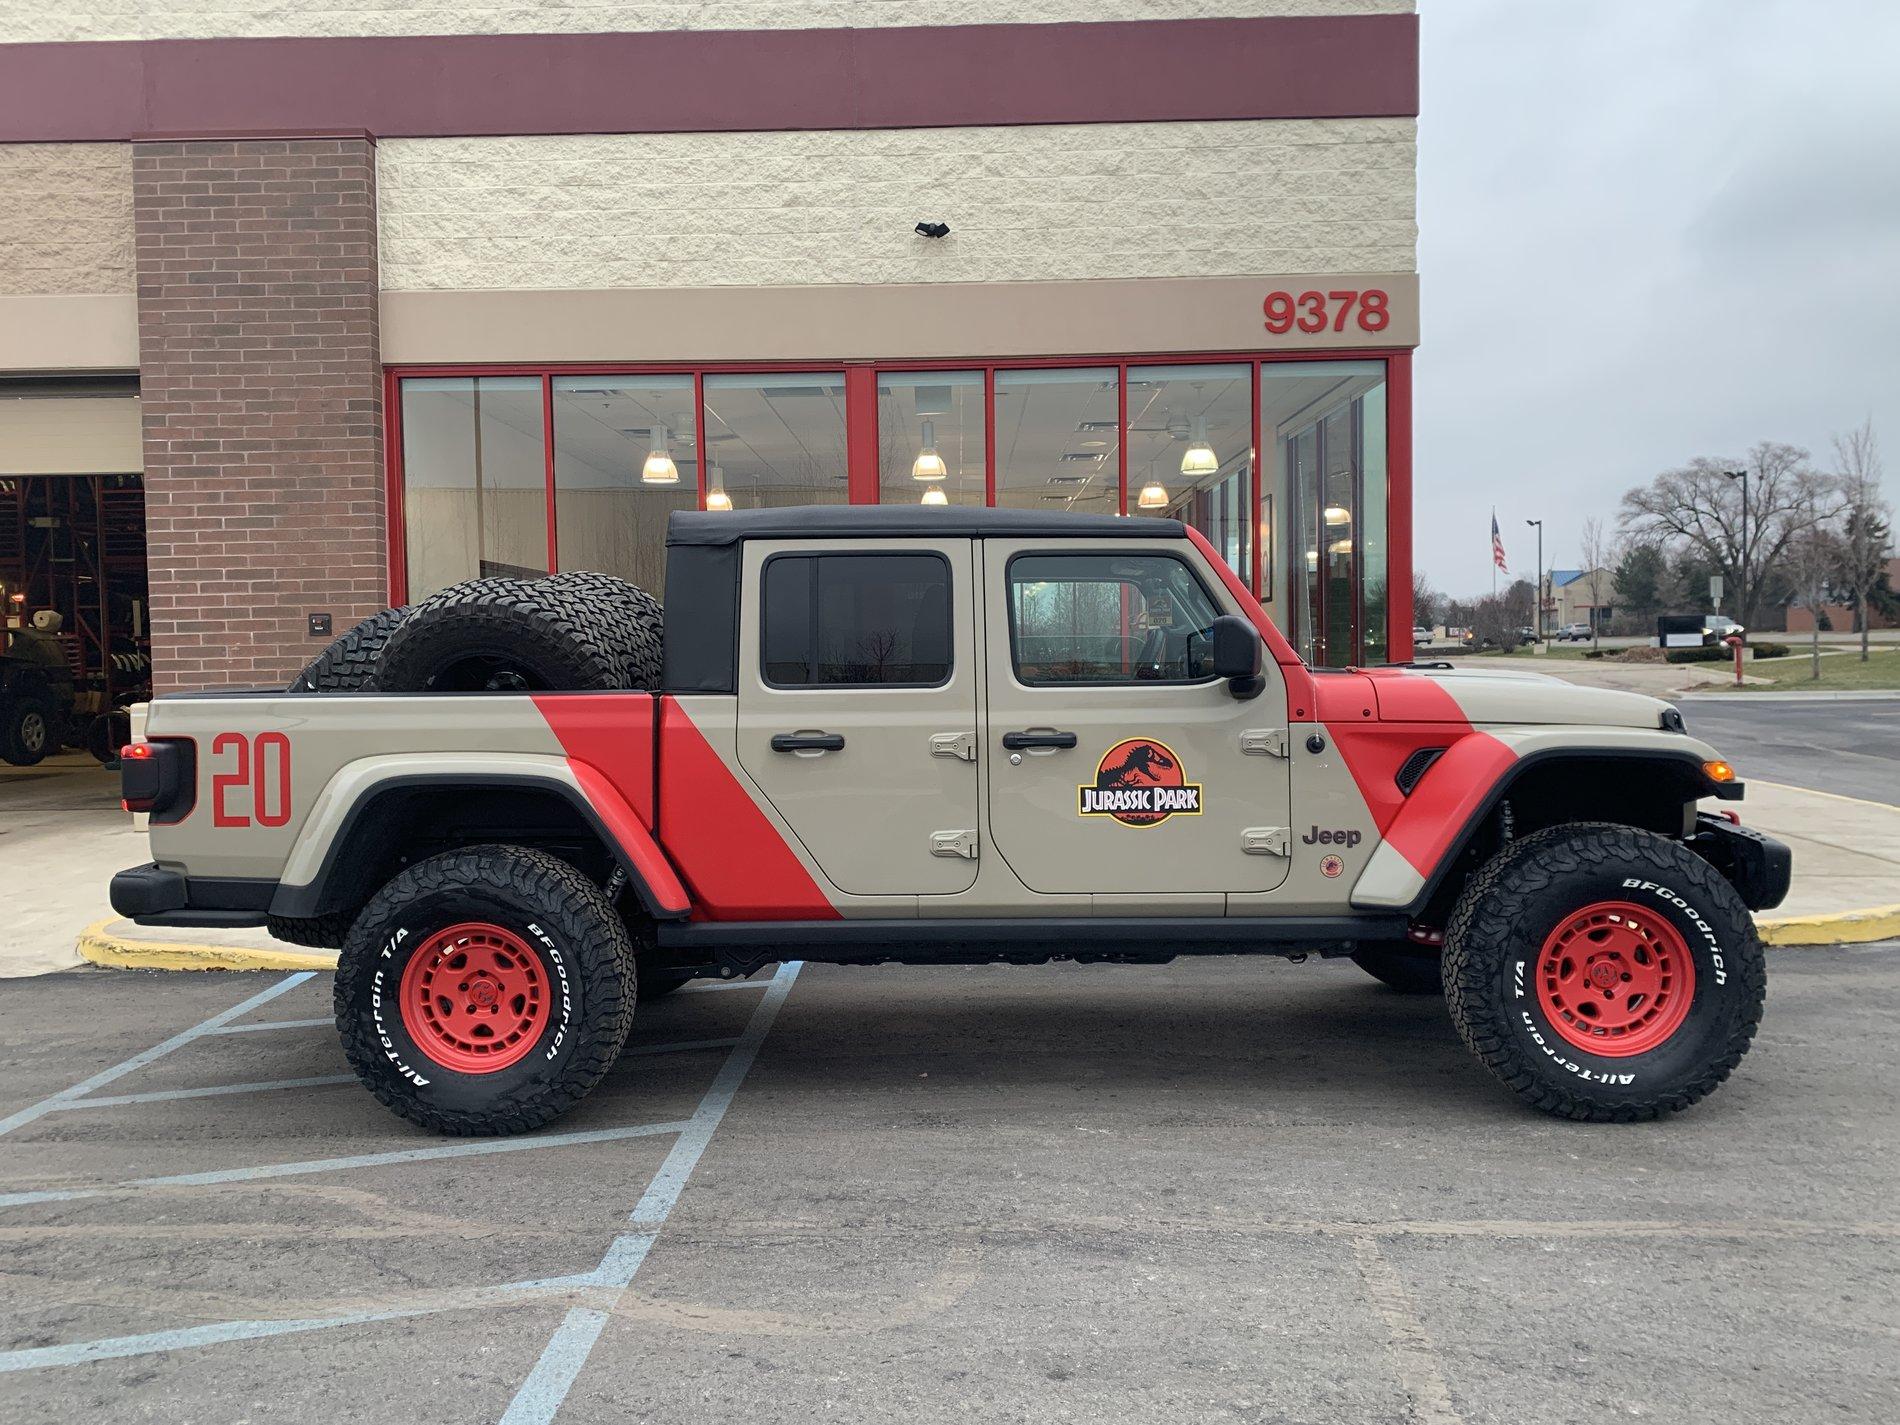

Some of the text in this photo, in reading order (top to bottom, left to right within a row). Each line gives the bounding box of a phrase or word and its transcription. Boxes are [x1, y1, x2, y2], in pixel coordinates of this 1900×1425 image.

[1263, 289, 1390, 334] 9378
[212, 731, 291, 828] 20
[1082, 787, 1199, 813] JURASSIC PARK
[1302, 825, 1361, 848] Jeep
[1622, 878, 1728, 986] BFGoodrich
[370, 927, 431, 1088] All-Terrain T/A
[527, 922, 573, 1061] BFGoodrich
[1514, 960, 1636, 1086] All-Terrain T/A
